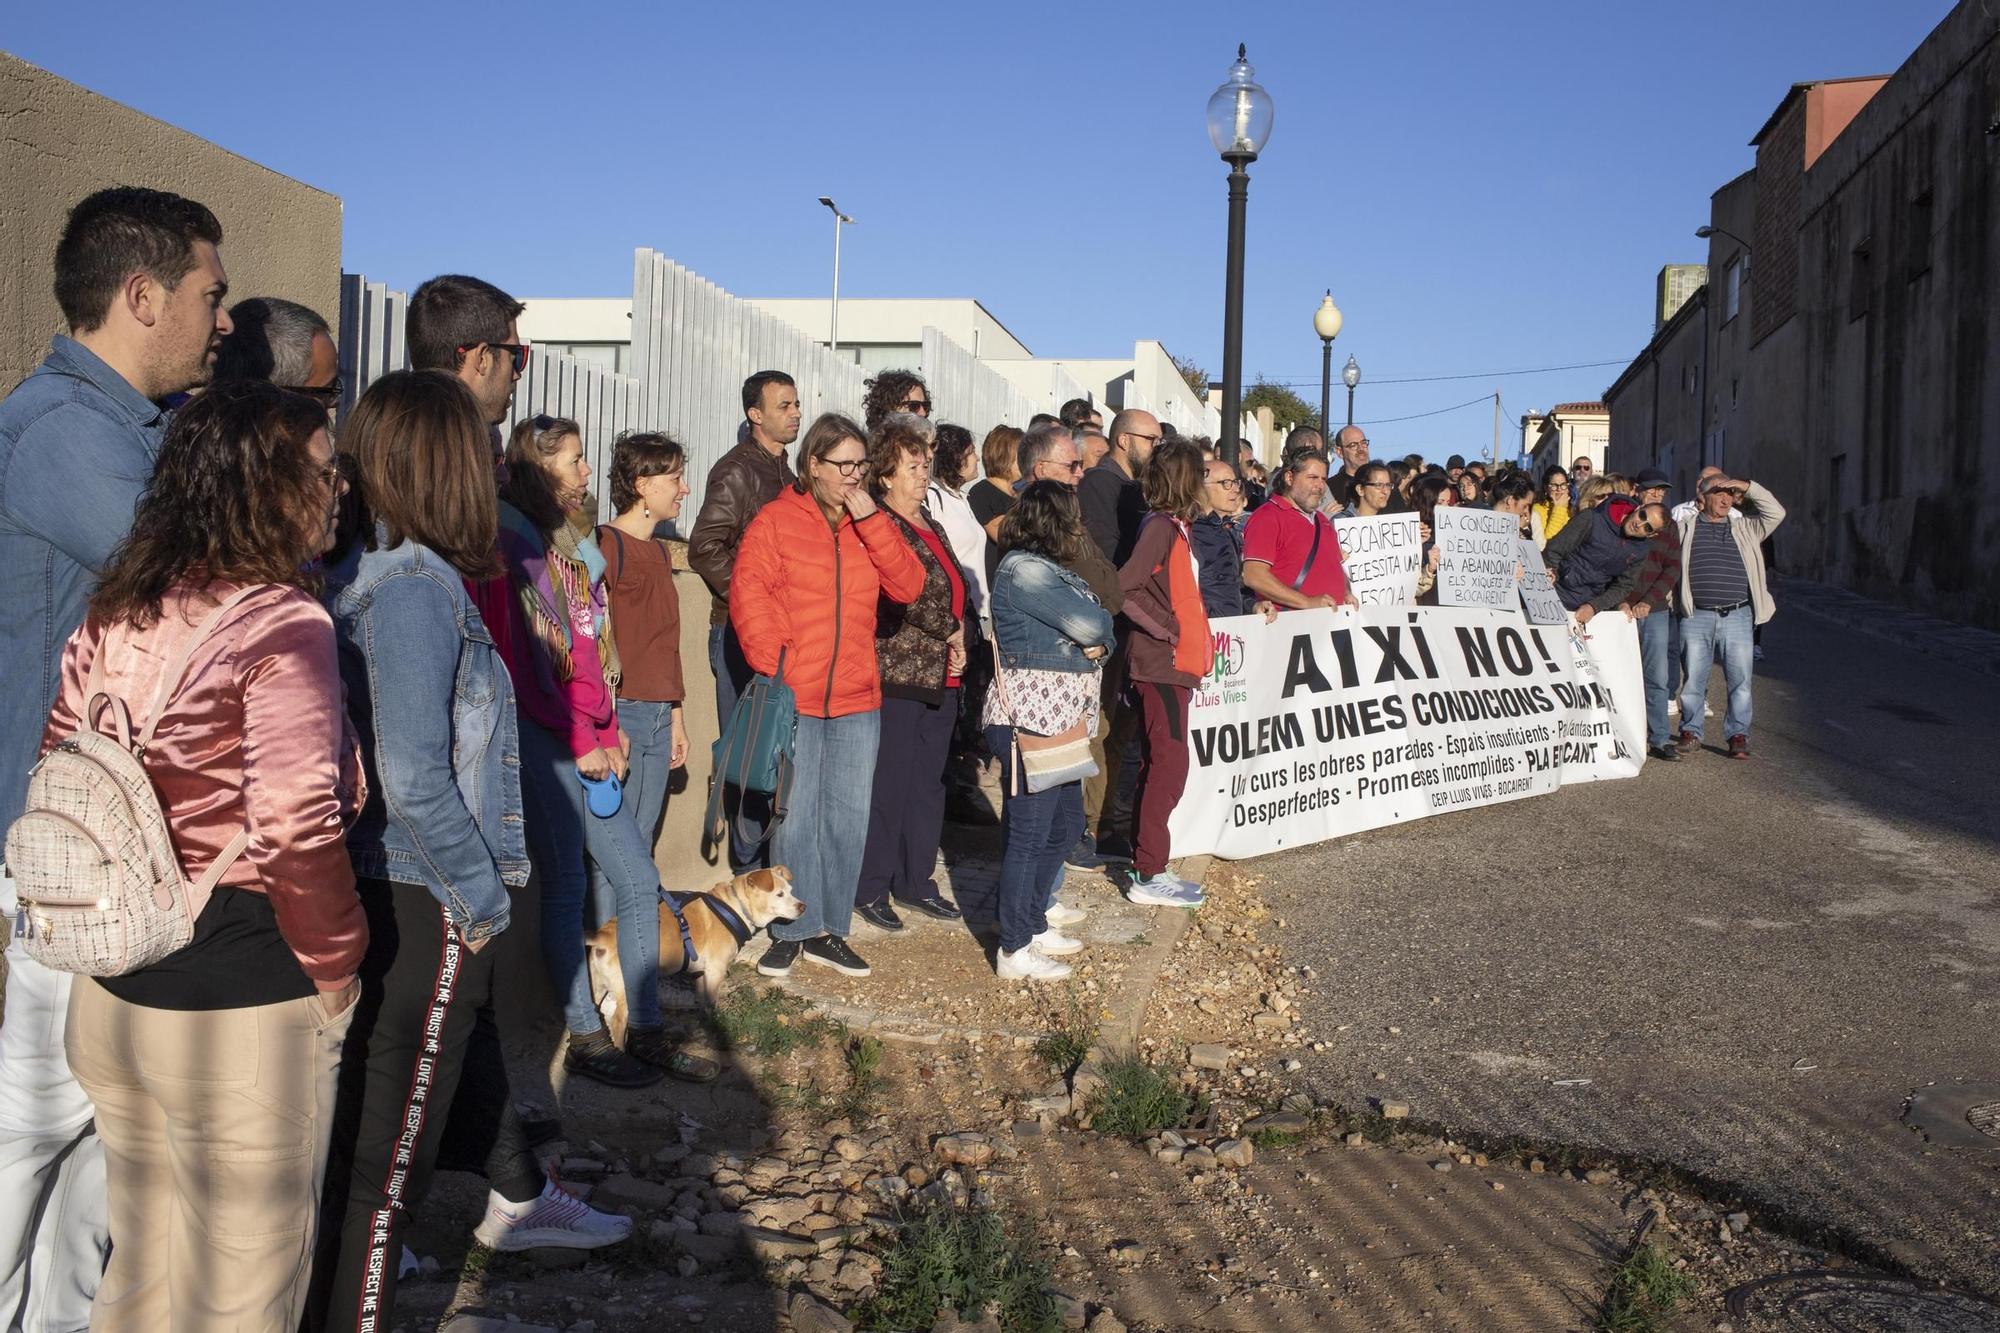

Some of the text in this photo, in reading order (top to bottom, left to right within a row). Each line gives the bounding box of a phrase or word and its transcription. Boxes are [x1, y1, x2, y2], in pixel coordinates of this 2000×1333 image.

[1439, 514, 1453, 530] LA
[1337, 520, 1420, 555] BOCAIRENT
[1348, 555, 1402, 583] ECESSITA
[1439, 557, 1517, 577] HA ABANDONAT
[1448, 575, 1466, 586] ELS
[1455, 588, 1508, 604] BOCAIRENT
[1454, 626, 1561, 679] NO!
[1223, 690, 1247, 704] Vives
[1191, 712, 1305, 768] VOLEM
[1312, 694, 1408, 744] UNES
[1411, 685, 1555, 726] CONDICIONS
[1251, 768, 1288, 793] curs
[1294, 761, 1316, 784] les
[1319, 753, 1366, 779] obres
[1373, 739, 1434, 773] parades
[1446, 732, 1486, 758] Espais
[1487, 724, 1550, 751] insuficients
[1234, 785, 1340, 828] Desperfectes
[1358, 769, 1440, 800] Promeses
[1442, 754, 1515, 782] incomplides
[1525, 747, 1550, 773] PLA
[1431, 791, 1448, 808] CEIP
[1449, 785, 1472, 804] LLUIS
[1473, 784, 1493, 800] VIVES
[1498, 776, 1533, 796] BOCAIRENT
[439, 944, 460, 988] RESPECT
[436, 988, 451, 1004] ME
[425, 1006, 444, 1038] TRUST
[424, 1039, 438, 1055] ME
[416, 1058, 433, 1085] LOVE
[412, 1086, 428, 1102] ME
[400, 1105, 422, 1149] RESPECT
[396, 1148, 411, 1166] ME
[373, 1228, 388, 1244] ME
[365, 1248, 384, 1296] RESPECT
[362, 1295, 377, 1313] ME
